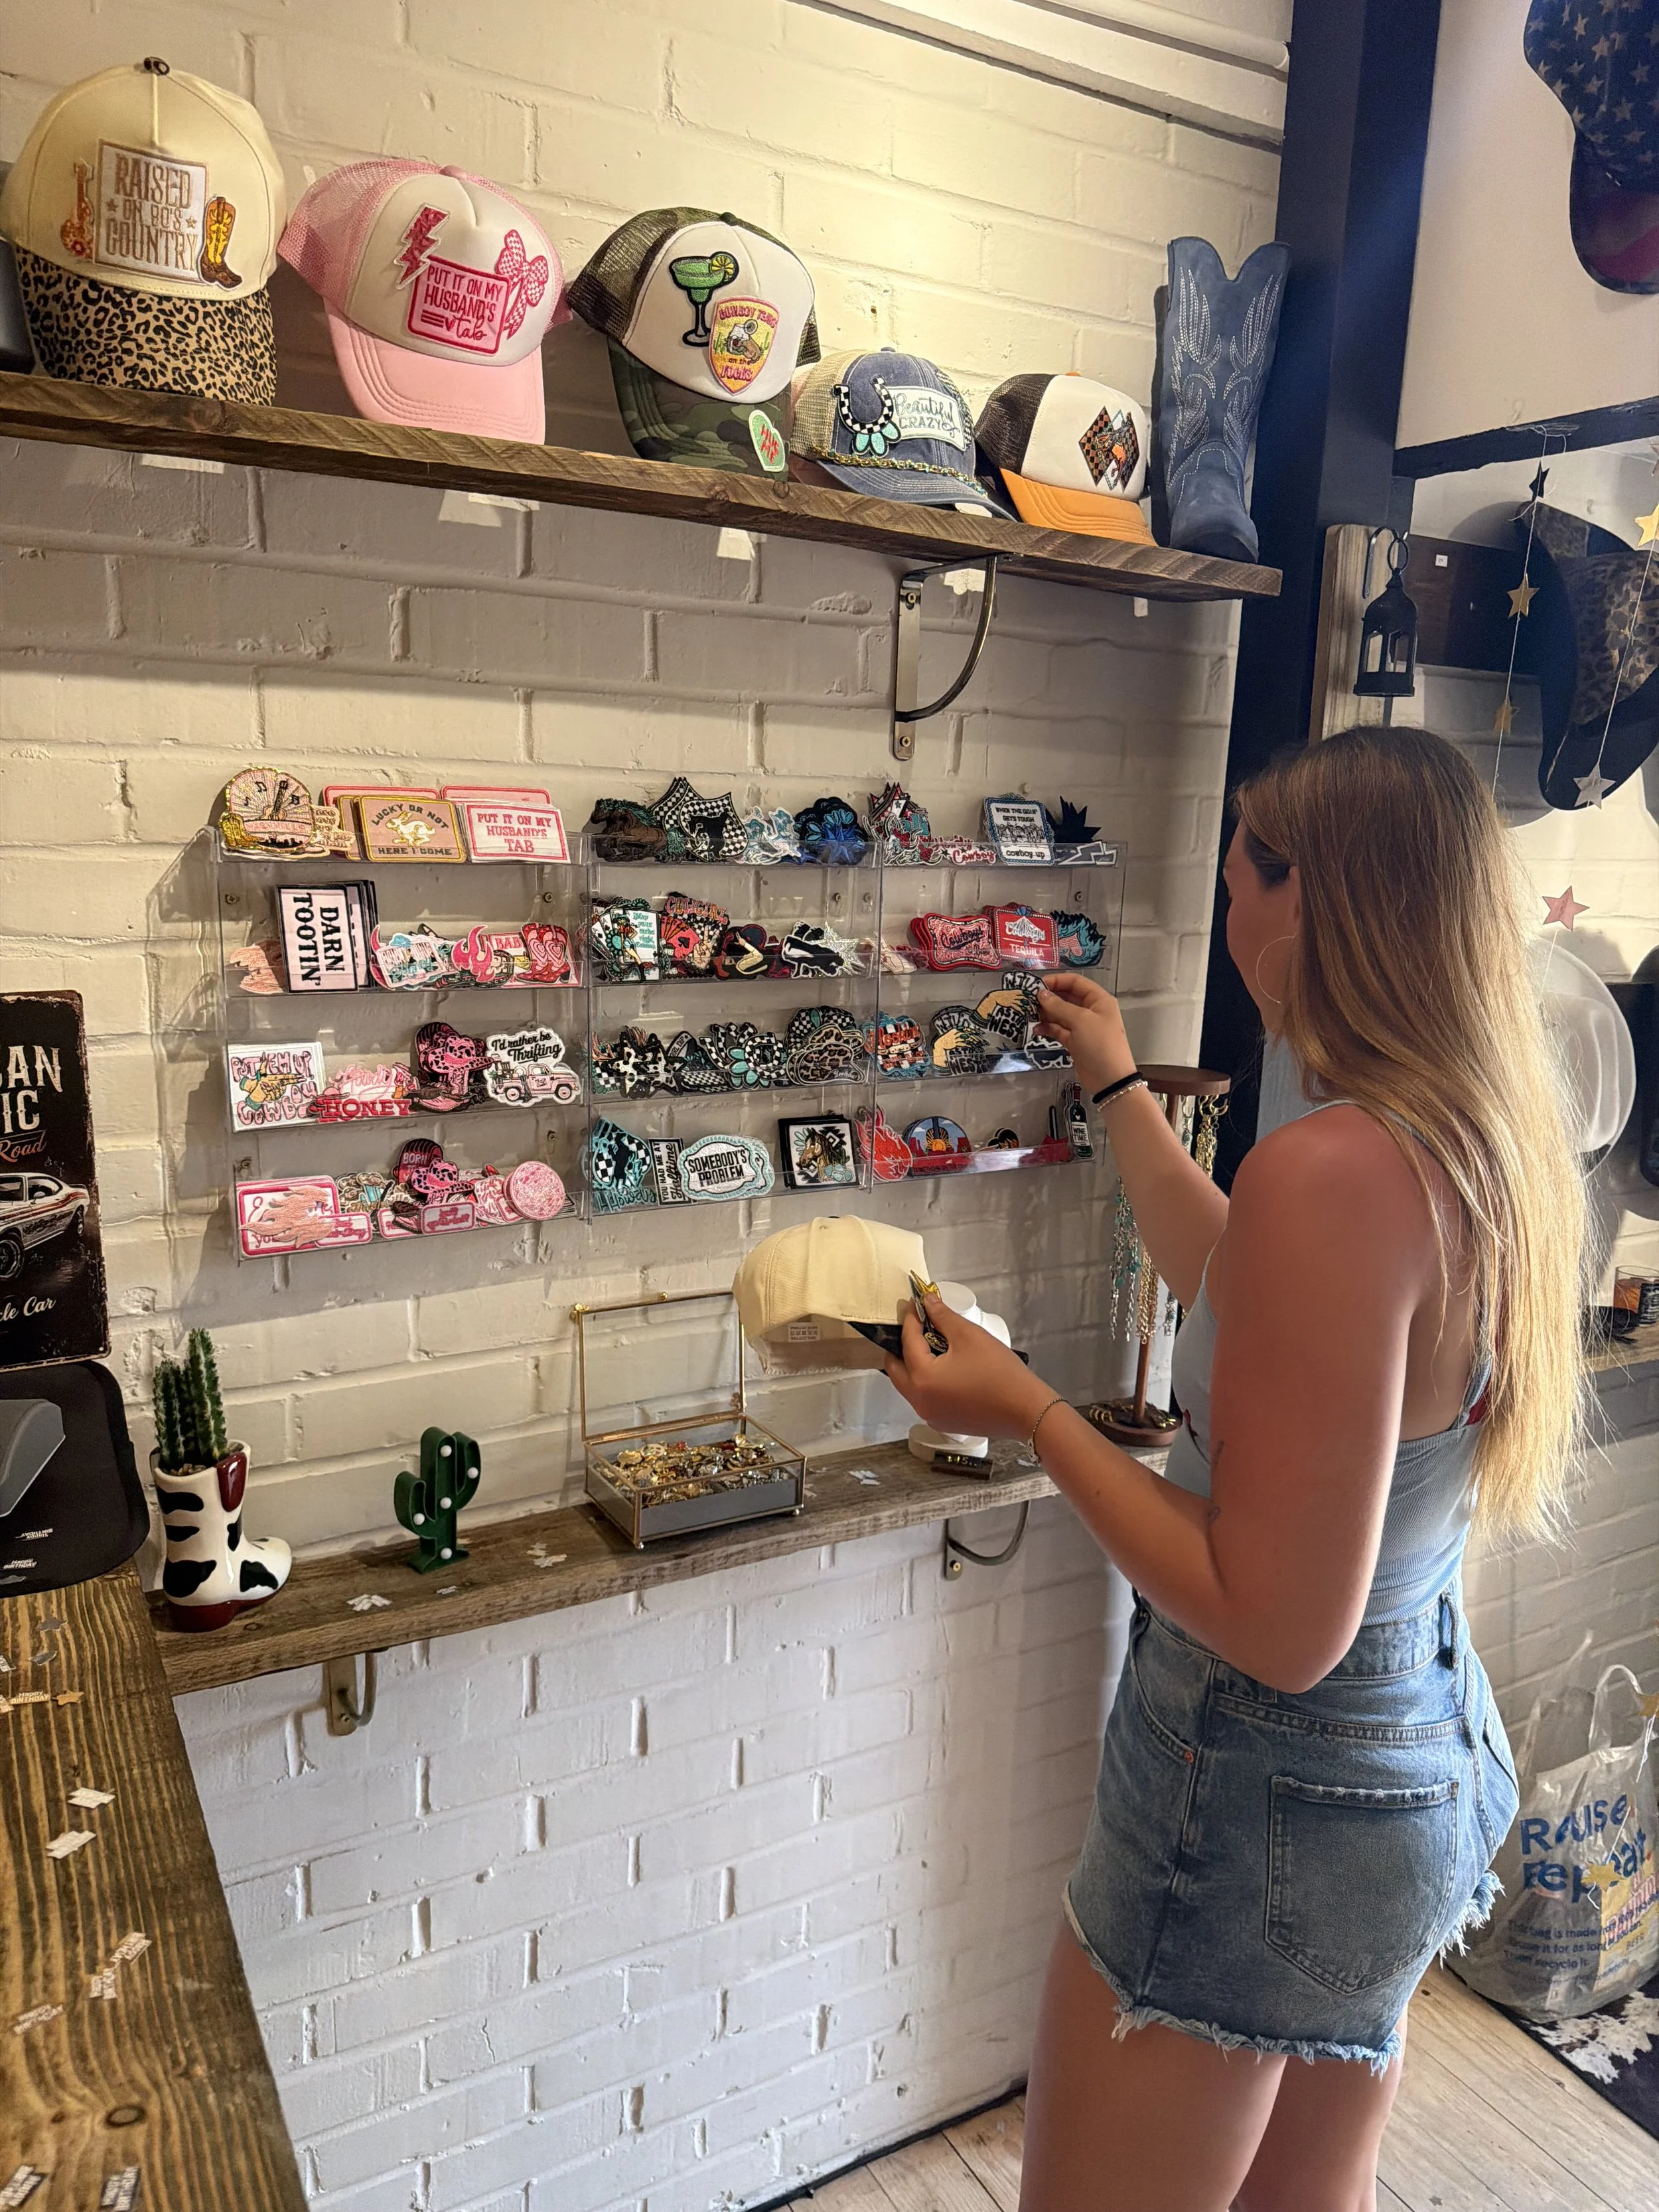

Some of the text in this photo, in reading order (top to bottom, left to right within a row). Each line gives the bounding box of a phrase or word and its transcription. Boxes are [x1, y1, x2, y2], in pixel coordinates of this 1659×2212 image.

[115, 153, 192, 209] RAISED
[122, 200, 143, 224] ON
[106, 218, 198, 271] COUNTRY
[427, 265, 504, 302] PUT IT ON MY
[424, 284, 496, 323] HUSBAND'S
[454, 315, 487, 340] tab
[894, 392, 958, 426] Beautiful
[899, 415, 942, 430] CRAZY
[371, 804, 449, 828] LUCKY OR NOT
[477, 813, 552, 827] PUT IT ON MY
[486, 825, 547, 837] HUSBAND'S
[504, 838, 536, 853] TAB
[953, 849, 996, 864] Cowboy
[665, 896, 728, 924] COWGIRL
[293, 893, 321, 986] TOOTIN'
[320, 907, 345, 972] DARN
[1009, 944, 1045, 957] TEQUILA
[996, 1007, 1012, 1018] AS
[989, 1017, 1024, 1043] WEST
[491, 1031, 552, 1052] I'd rather be
[508, 1043, 564, 1063] Thrifting
[0, 1045, 63, 1092] AN
[231, 1057, 261, 1082] PUT
[324, 1098, 411, 1116] HONEY
[654, 1142, 662, 1152] AT
[656, 1157, 664, 1166] ME
[688, 1149, 747, 1173] SOMEBODY'S
[657, 1168, 666, 1184] HAD
[697, 1164, 745, 1187] PROBLEM
[23, 1296, 56, 1316] Car
[3, 1561, 38, 1570] BIRTHDAY
[10, 1694, 49, 1704] BIRTHDAY
[1565, 1927, 1597, 1938] made
[1554, 1943, 1569, 1954] for
